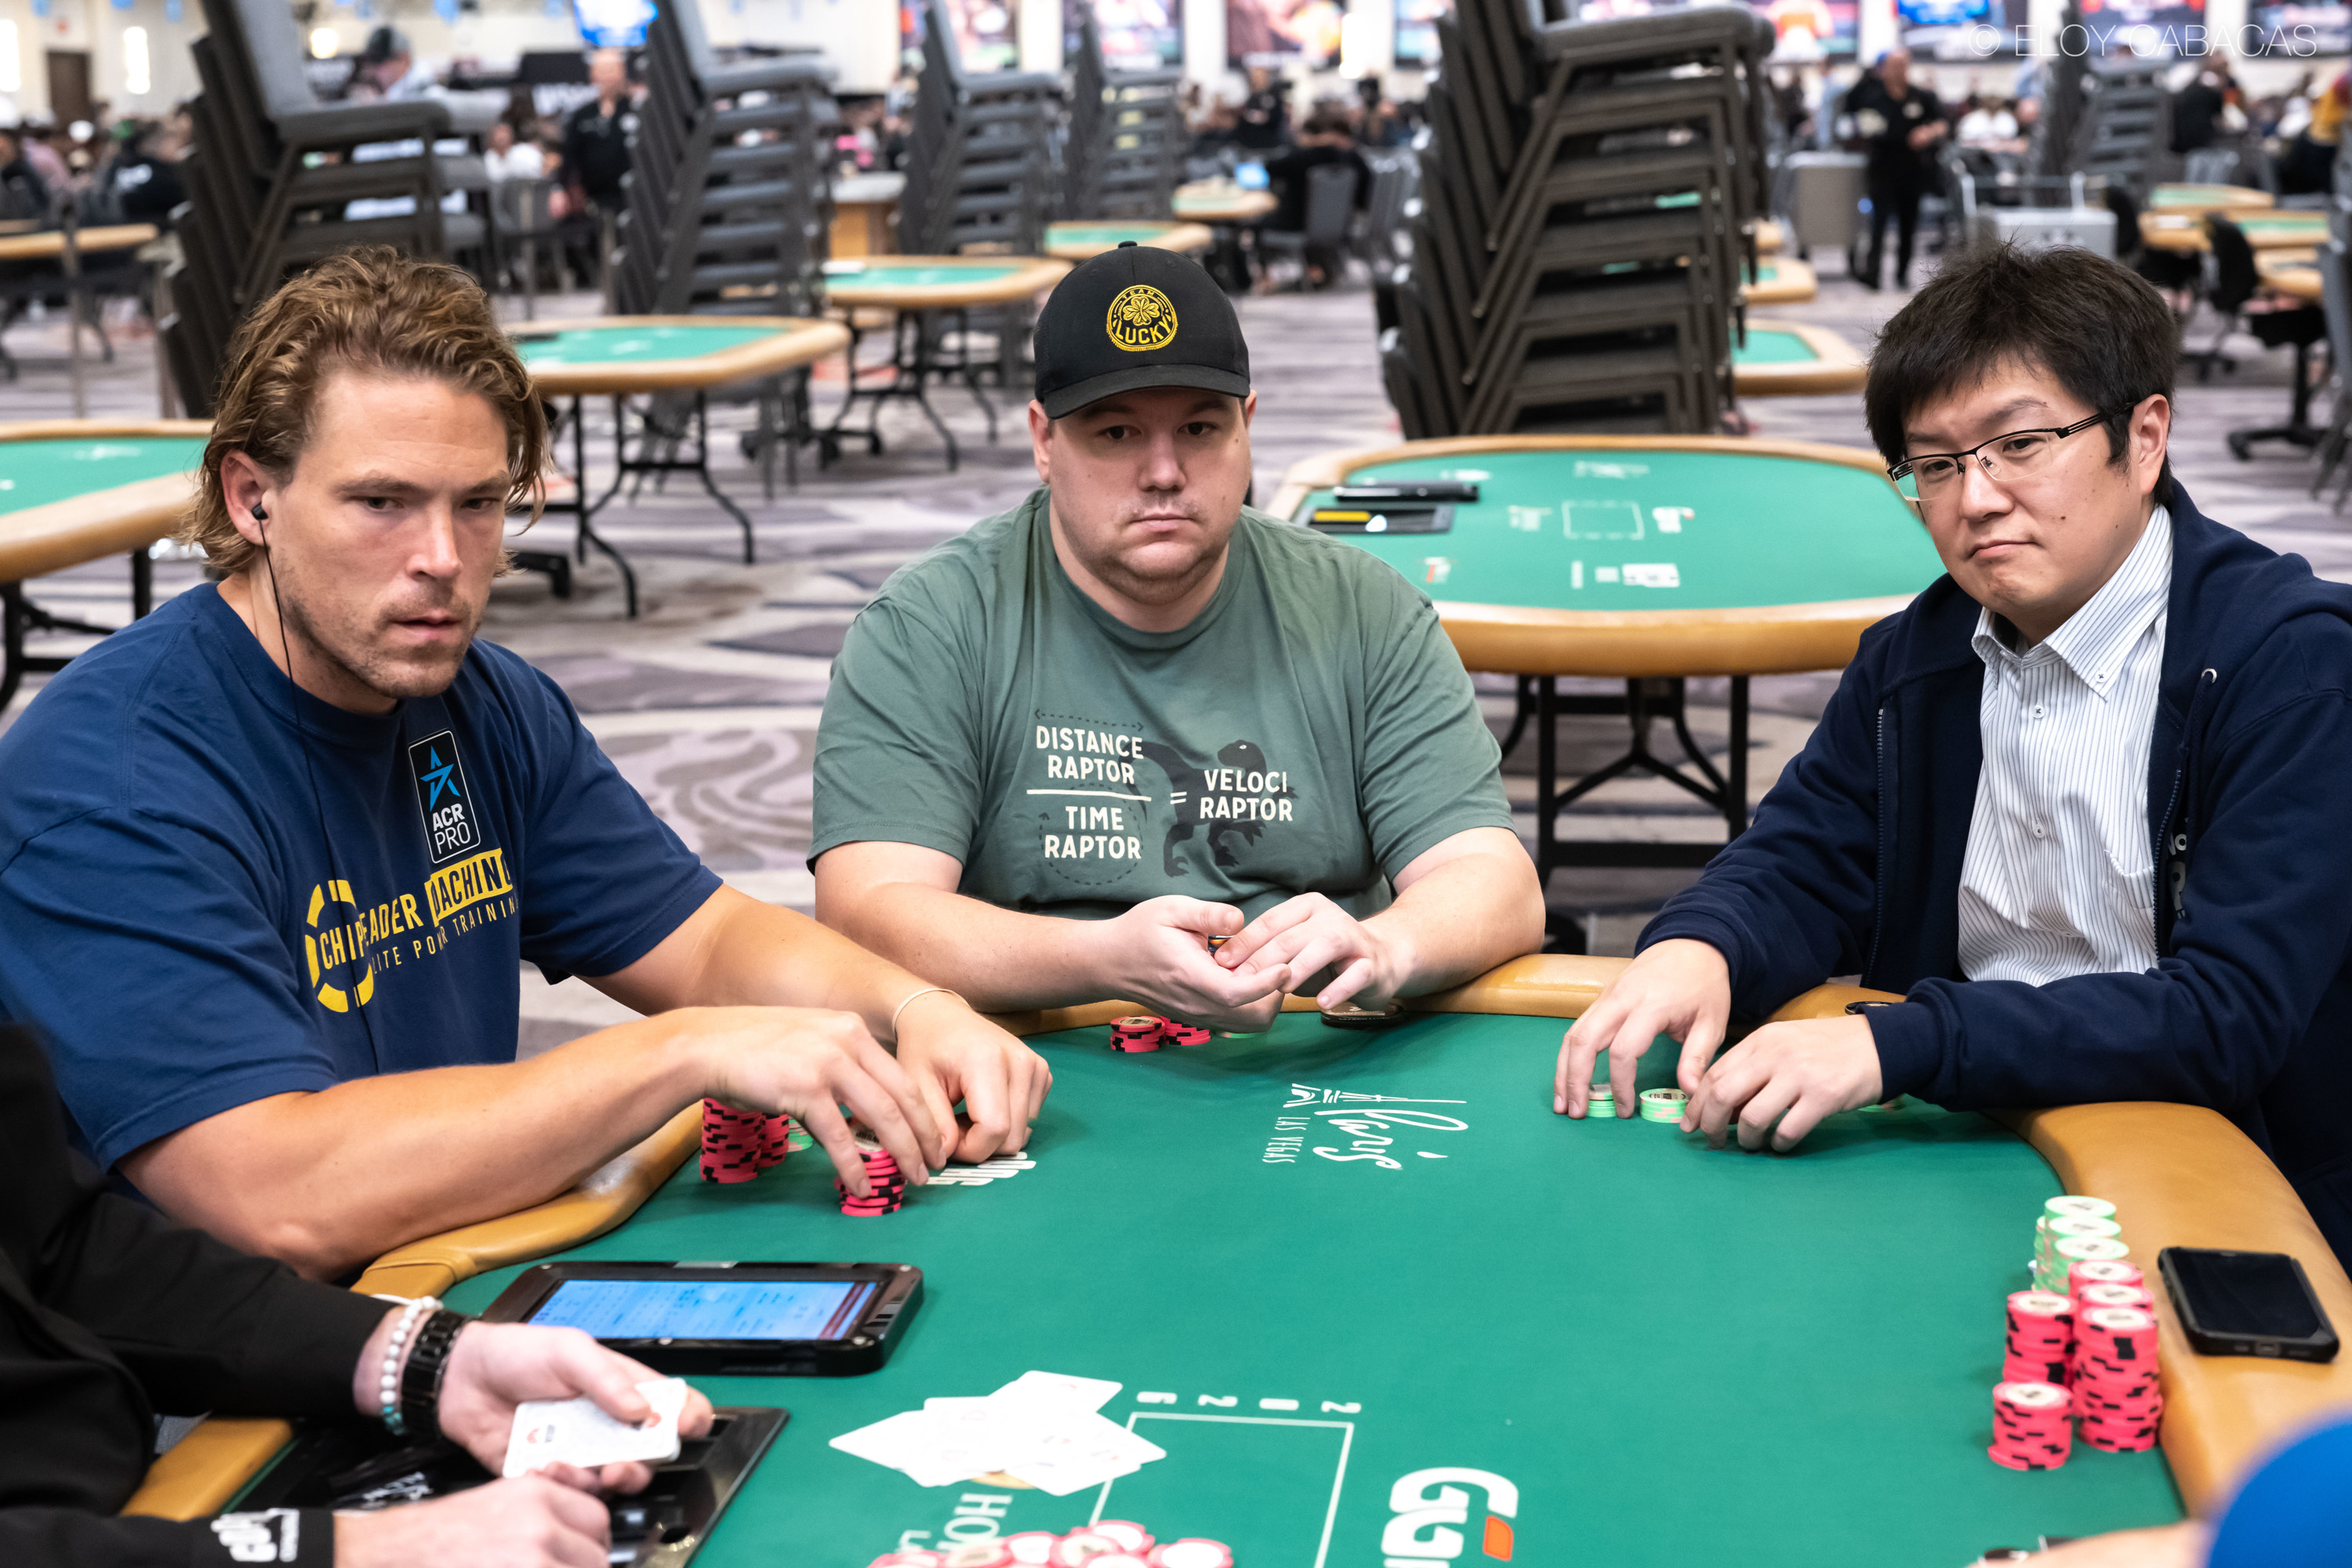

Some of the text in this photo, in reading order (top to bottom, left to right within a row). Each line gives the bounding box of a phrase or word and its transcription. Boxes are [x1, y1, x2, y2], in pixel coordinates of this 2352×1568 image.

[1122, 289, 1155, 299] TEAM
[1115, 315, 1171, 344] LUCKY
[1036, 725, 1145, 760] DISTANCE
[1047, 755, 1135, 785] RAPTOR
[1204, 768, 1287, 793] VELOCI
[432, 803, 466, 832] ACR
[1065, 806, 1124, 831] TIME
[1200, 797, 1294, 822] RAPTOR
[434, 822, 471, 855] PRO
[1044, 834, 1142, 859] RAPTOR
[452, 895, 518, 936] TRAININ
[1261, 1116, 1311, 1163] LAS VEGAS
